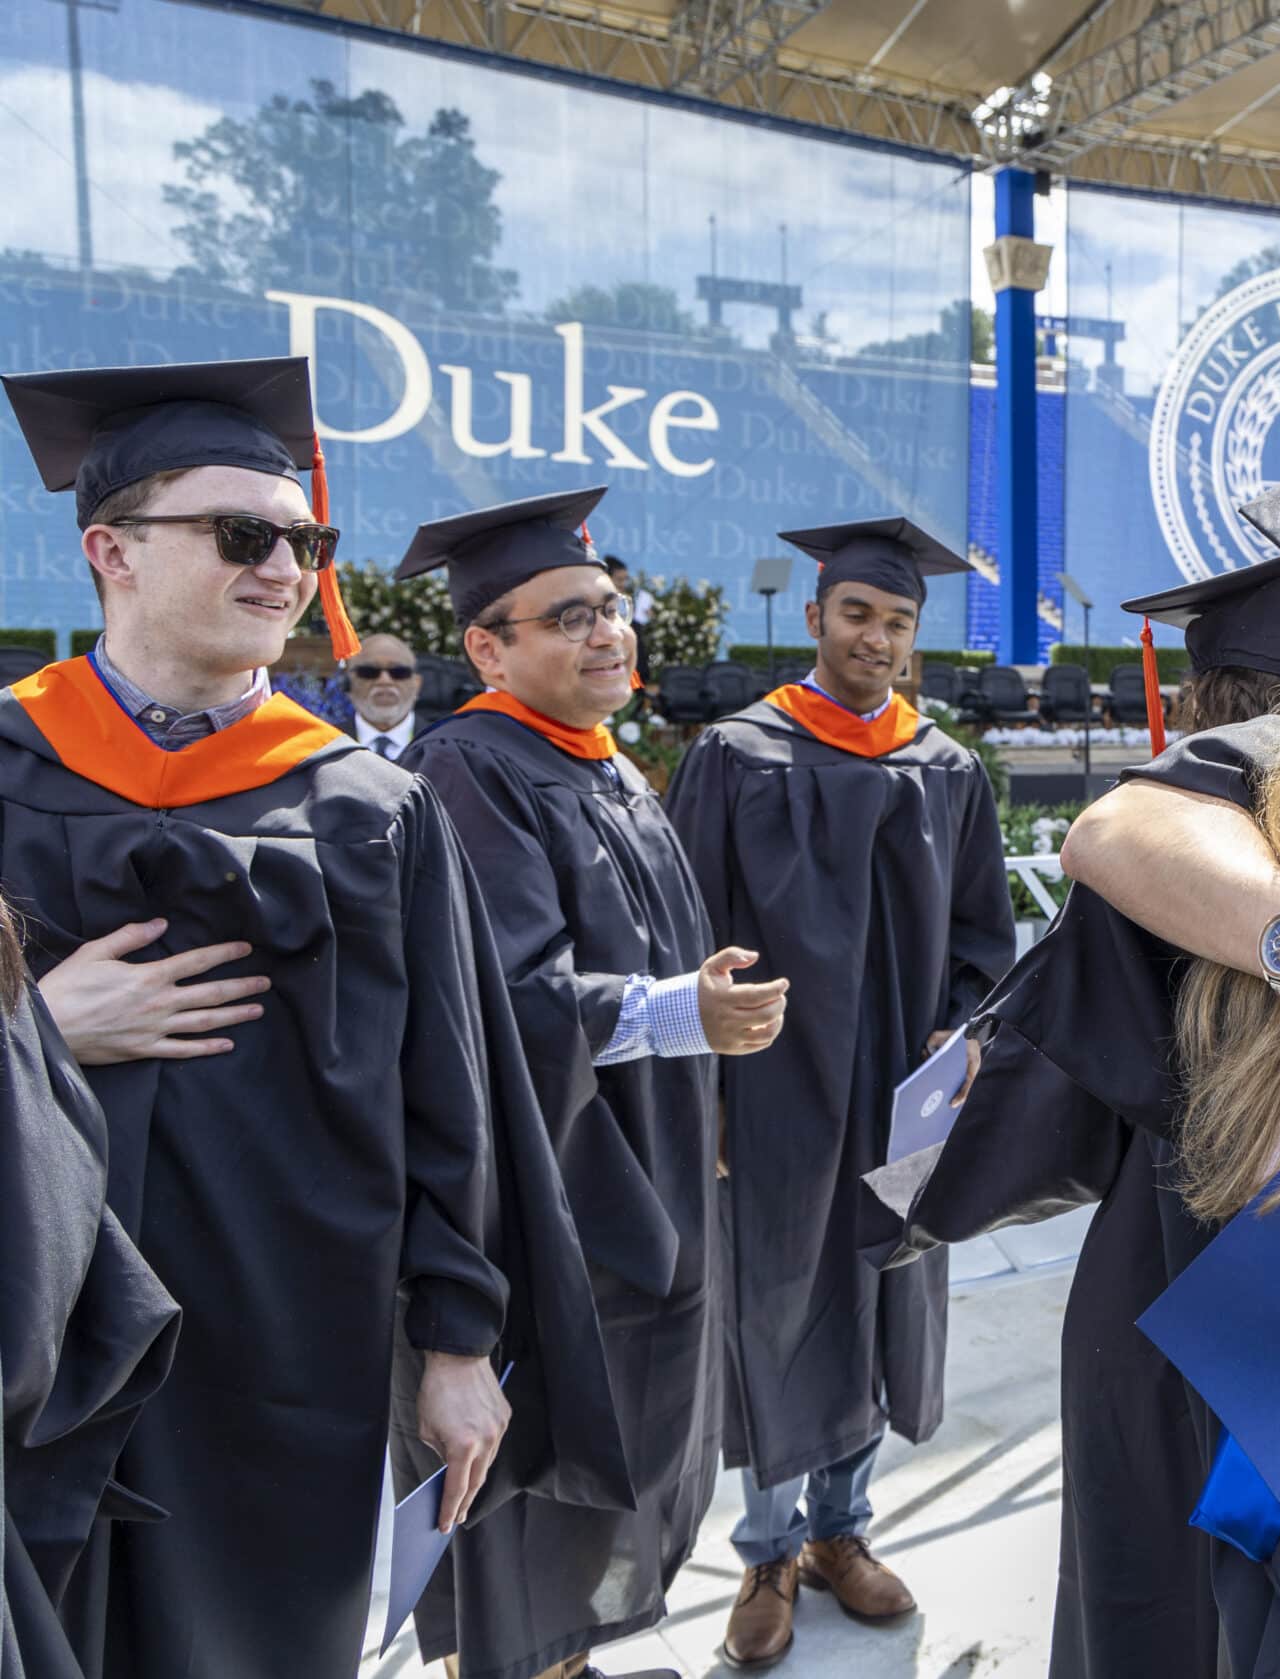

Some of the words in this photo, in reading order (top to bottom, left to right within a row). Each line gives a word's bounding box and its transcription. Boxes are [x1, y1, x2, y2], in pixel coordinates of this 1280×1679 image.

[79, 270, 239, 330] Duke
[265, 290, 719, 478] Duke
[1185, 314, 1269, 424] DUKE
[712, 463, 820, 506] Duke
